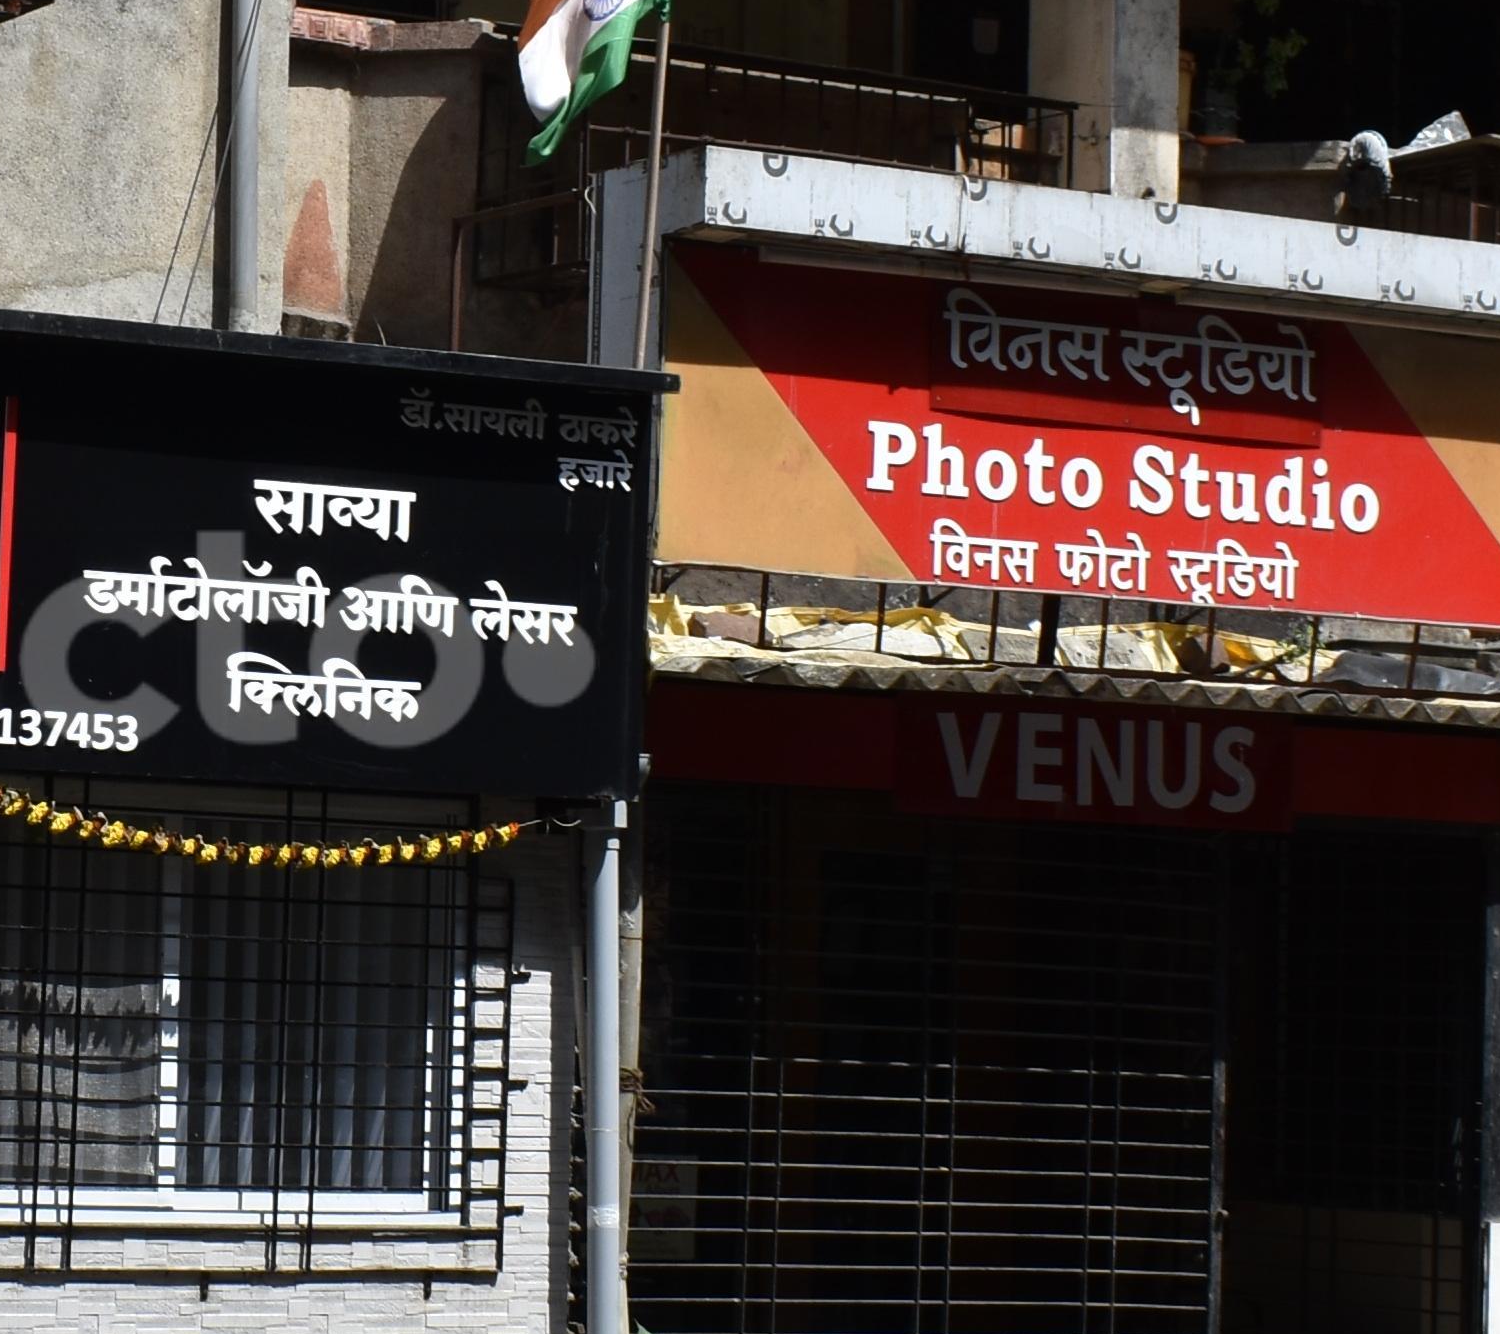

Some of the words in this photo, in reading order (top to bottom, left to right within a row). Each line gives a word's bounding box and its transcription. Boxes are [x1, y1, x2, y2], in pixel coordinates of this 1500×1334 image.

[943, 288, 1110, 382] विनस
[1120, 314, 1317, 426] स्टूडियो
[557, 449, 634, 493] हजारे
[558, 406, 639, 448] ठाकरे
[254, 478, 417, 543] साव्या
[866, 420, 1103, 510] Photo
[1129, 444, 1381, 534] Studio
[83, 555, 329, 628] डर्माटोलॉजी
[339, 574, 459, 638] आणि
[470, 580, 578, 647] लेसर
[929, 517, 1039, 584] विनस
[1054, 528, 1151, 592] फोटो
[1167, 538, 1299, 605] स्टूडियो
[226, 651, 422, 724] क्लिनिक
[935, 712, 1256, 813] VENUS
